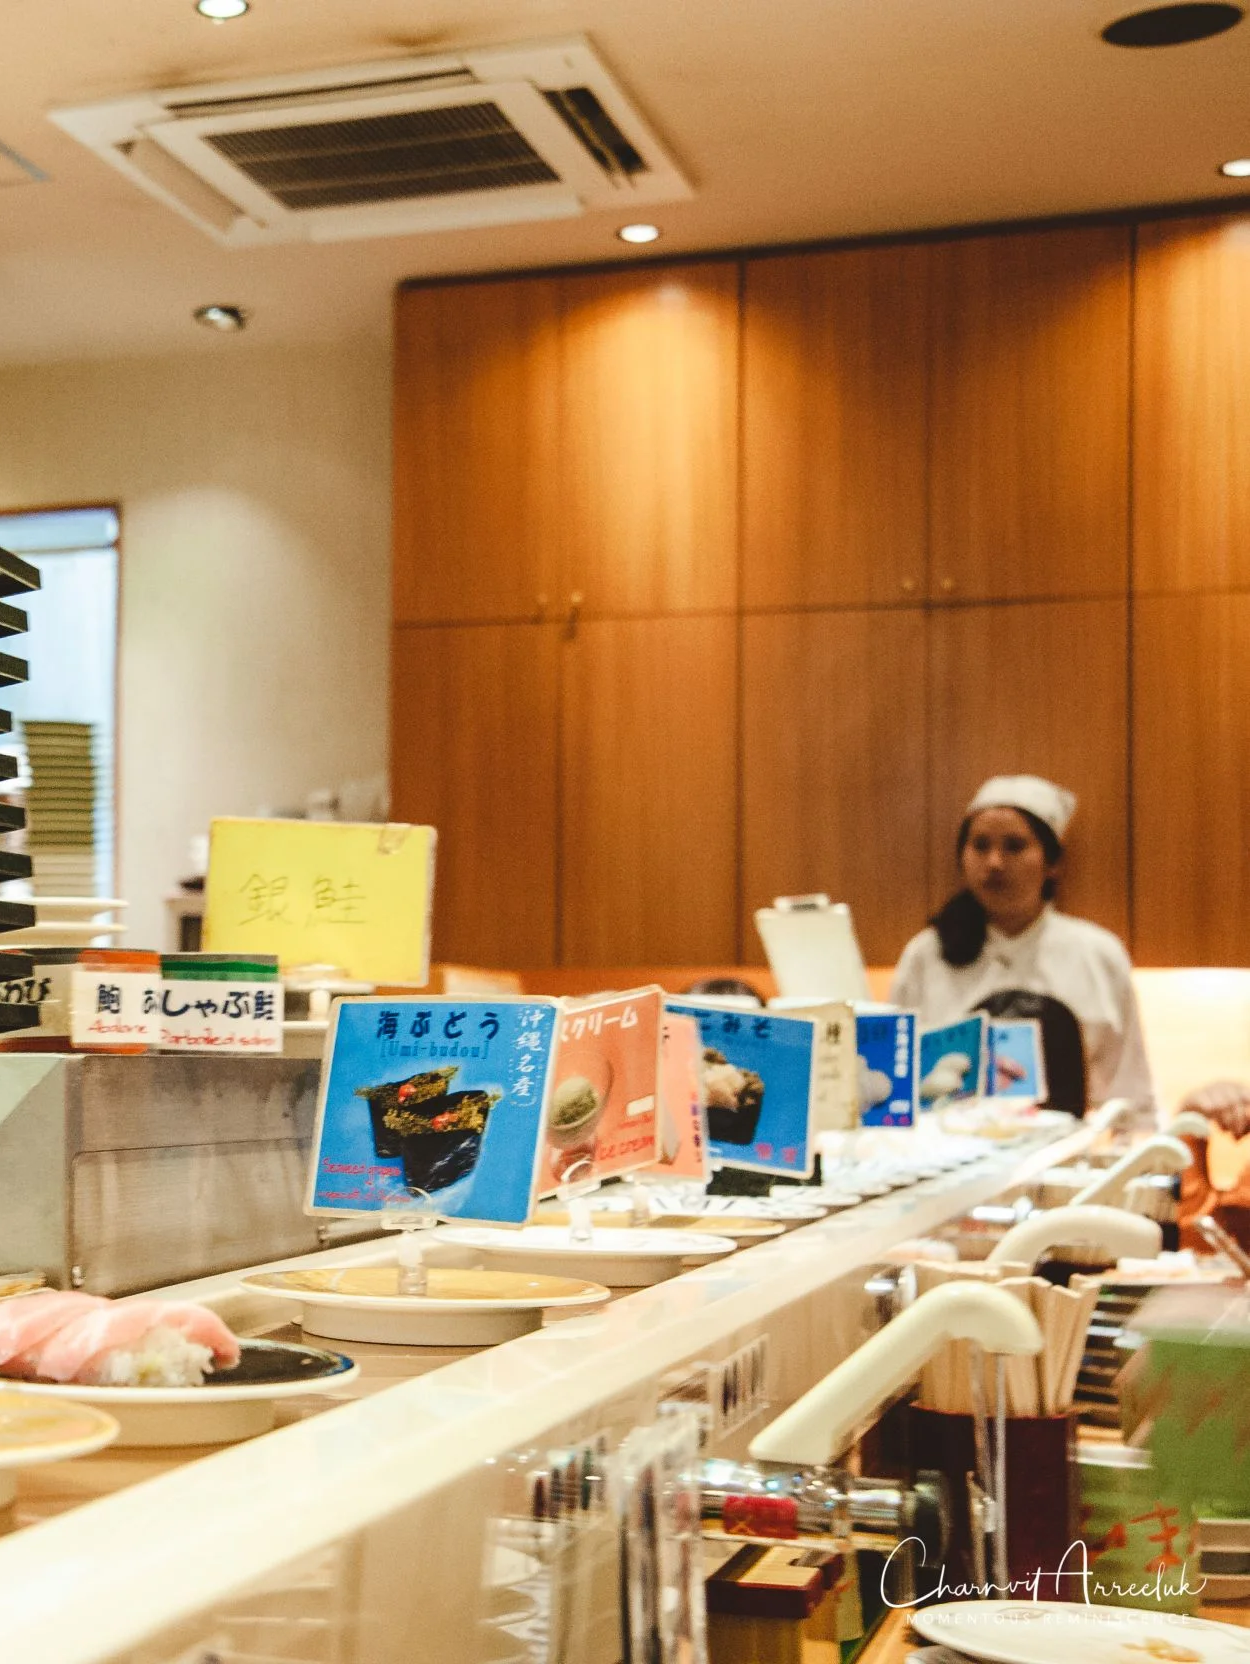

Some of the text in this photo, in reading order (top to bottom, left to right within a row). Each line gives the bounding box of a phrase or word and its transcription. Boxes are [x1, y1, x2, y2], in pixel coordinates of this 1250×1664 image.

[237, 872, 367, 928] 銀鮭
[376, 1010, 500, 1040] 海ぶどう
